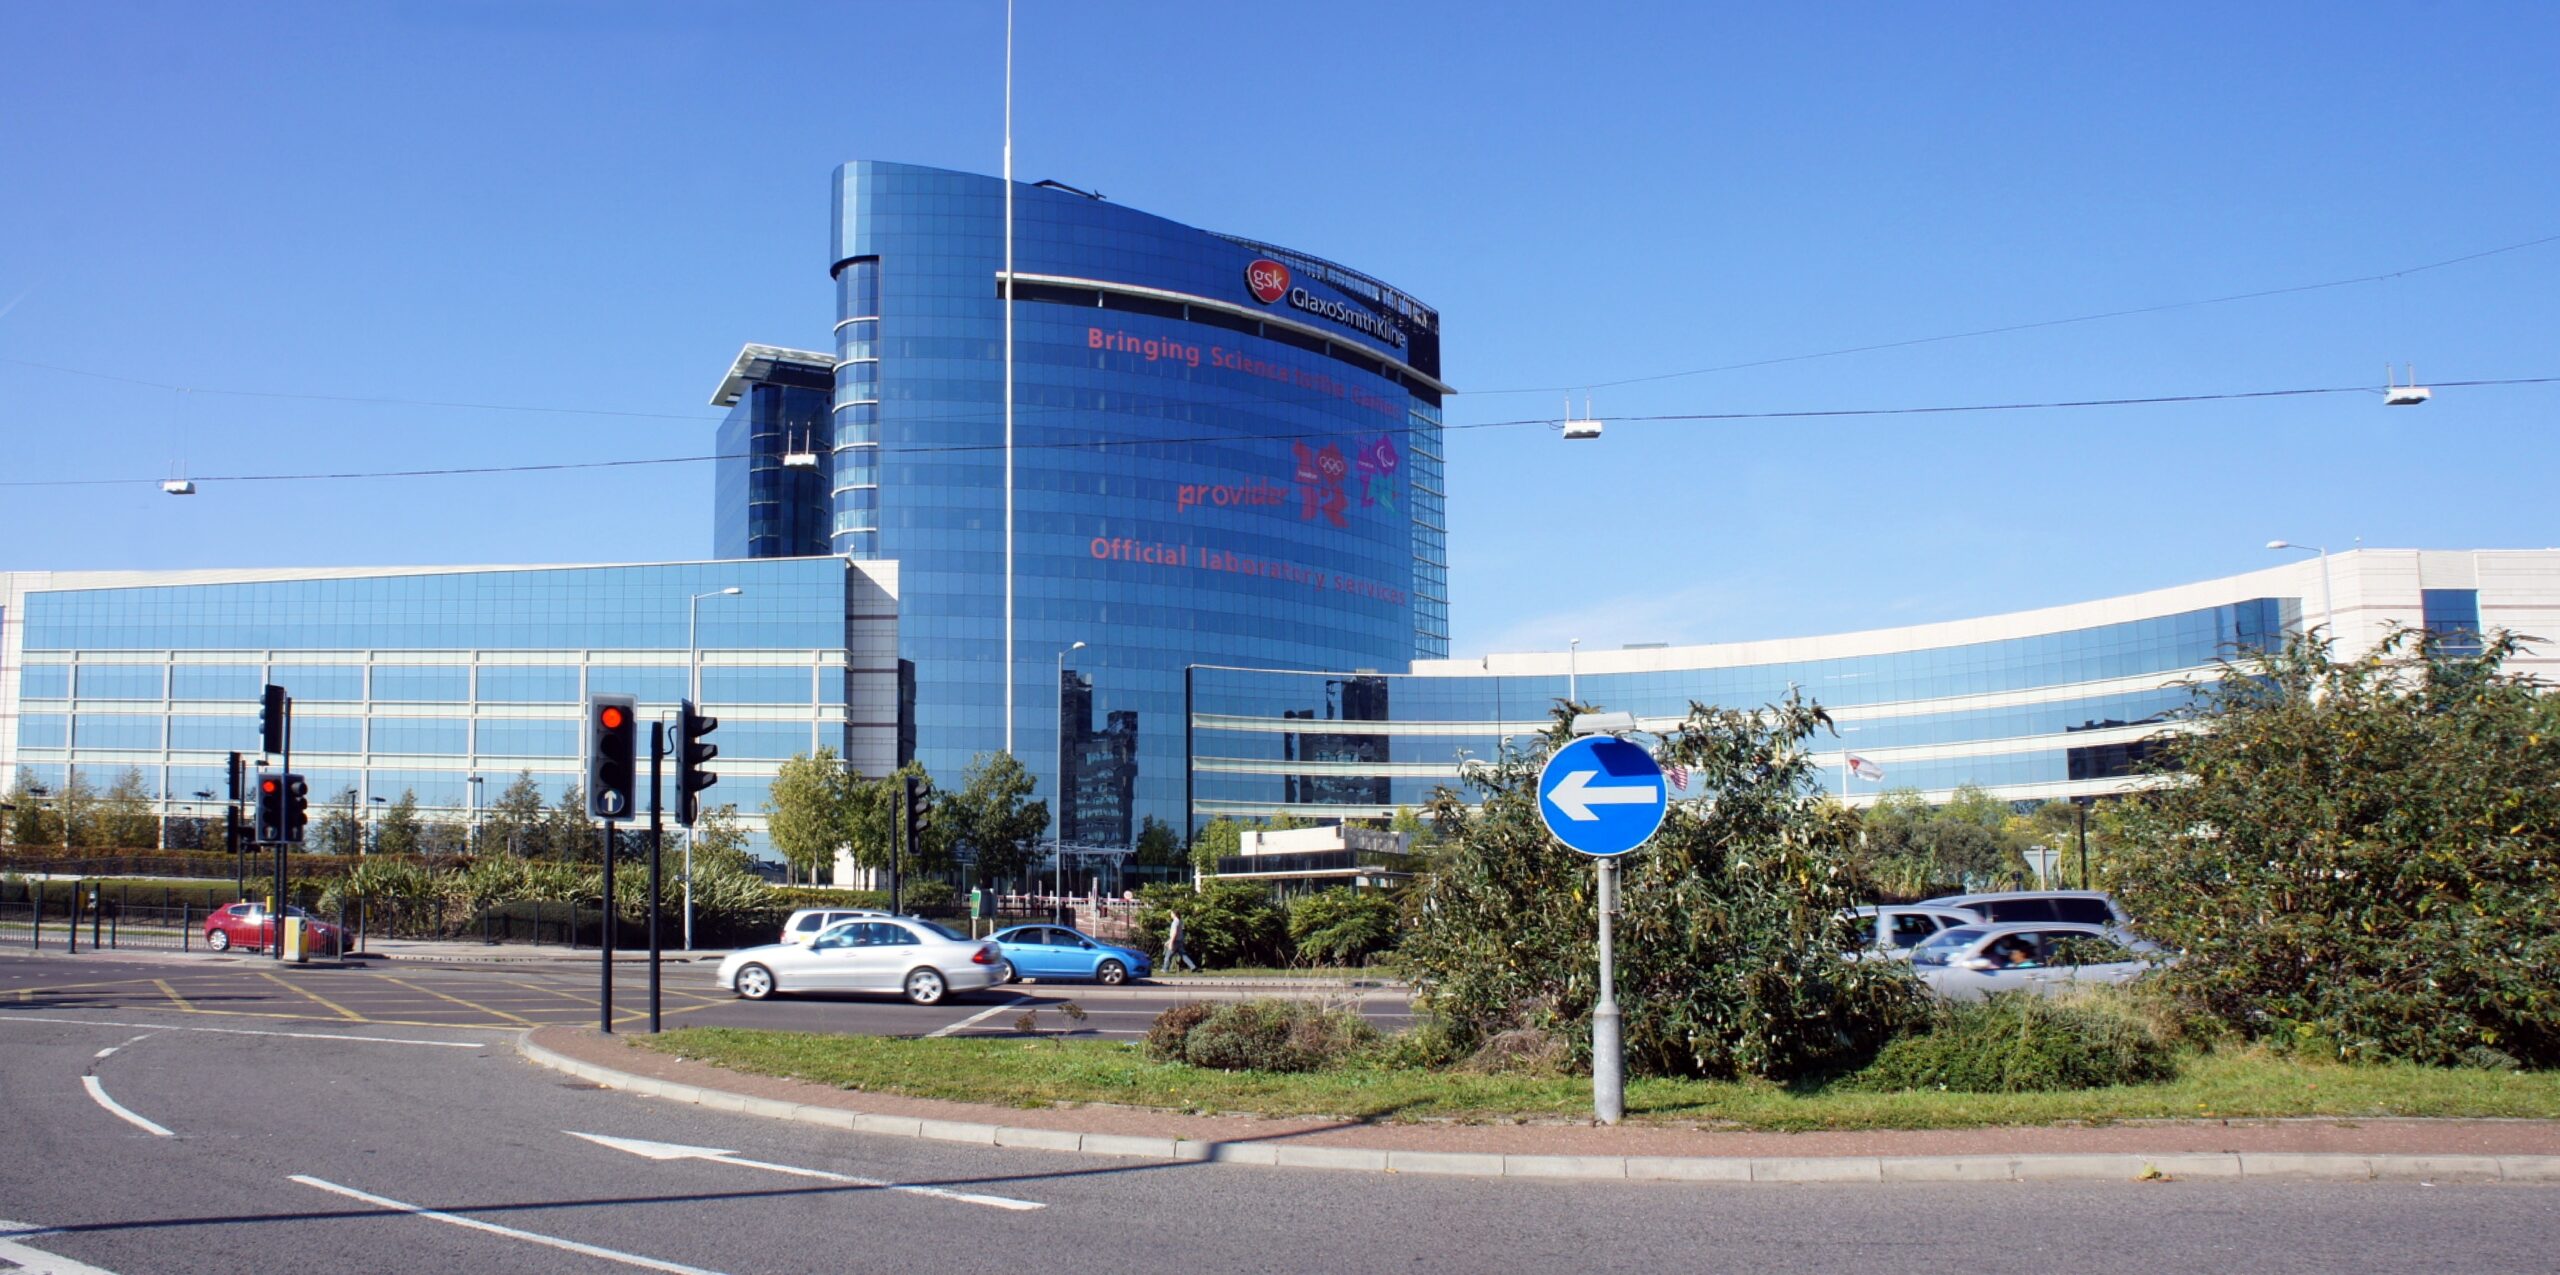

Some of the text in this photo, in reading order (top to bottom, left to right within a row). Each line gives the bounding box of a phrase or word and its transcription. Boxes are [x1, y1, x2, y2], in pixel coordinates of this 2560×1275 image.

[1253, 270, 1284, 292] gsk
[1292, 287, 1406, 348] GlaxoSmithKline
[1088, 327, 1200, 368] Bringing
[1211, 347, 1290, 384] Science
[1177, 475, 1289, 513] provider
[1090, 537, 1406, 608] Official laboratory services
